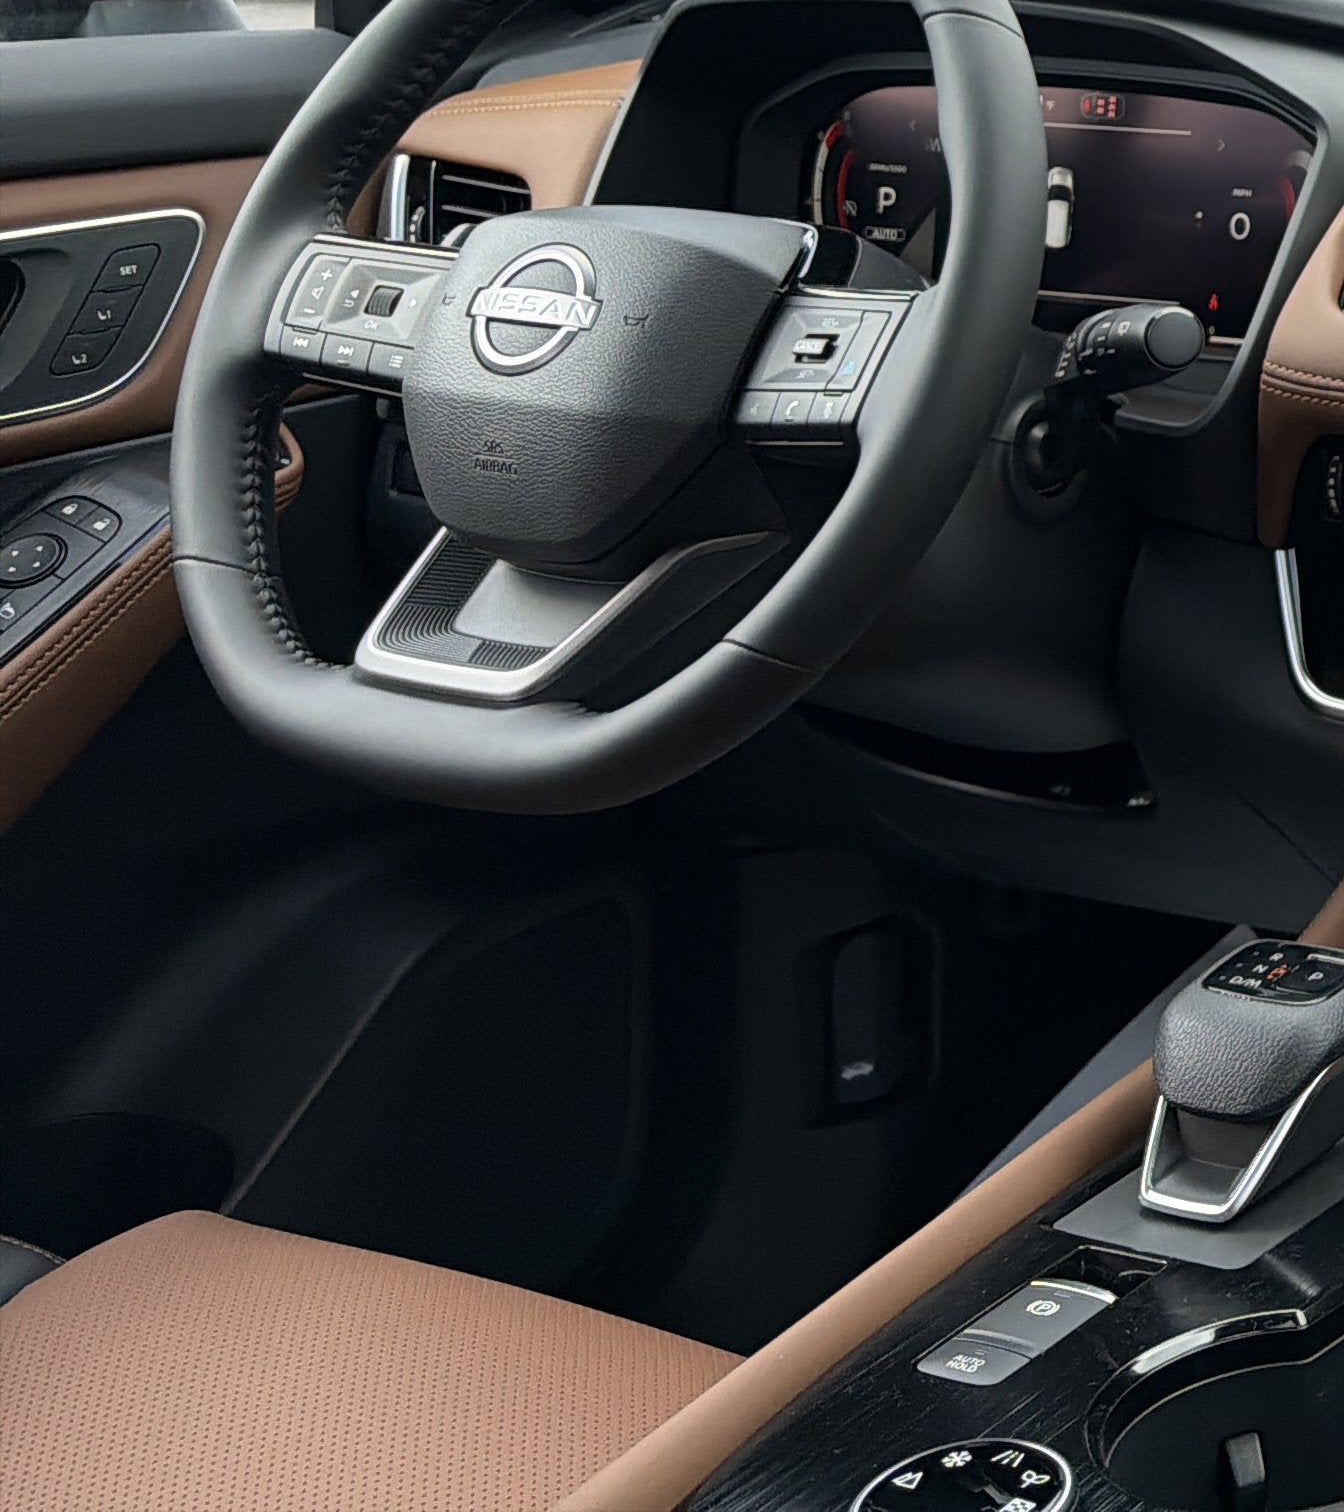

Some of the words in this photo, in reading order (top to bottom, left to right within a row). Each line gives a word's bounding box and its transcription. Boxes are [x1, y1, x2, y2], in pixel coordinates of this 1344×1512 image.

[877, 186, 897, 214] P
[1229, 212, 1251, 240] 0
[872, 228, 898, 240] AUTO
[120, 265, 138, 275] SET
[471, 291, 597, 325] NISSAN
[1269, 953, 1284, 961] R
[1252, 964, 1269, 973] N
[1229, 976, 1263, 988] D/M
[1307, 972, 1324, 980] P
[945, 1360, 979, 1373] HOLD
[952, 1354, 985, 1367] AUTO
